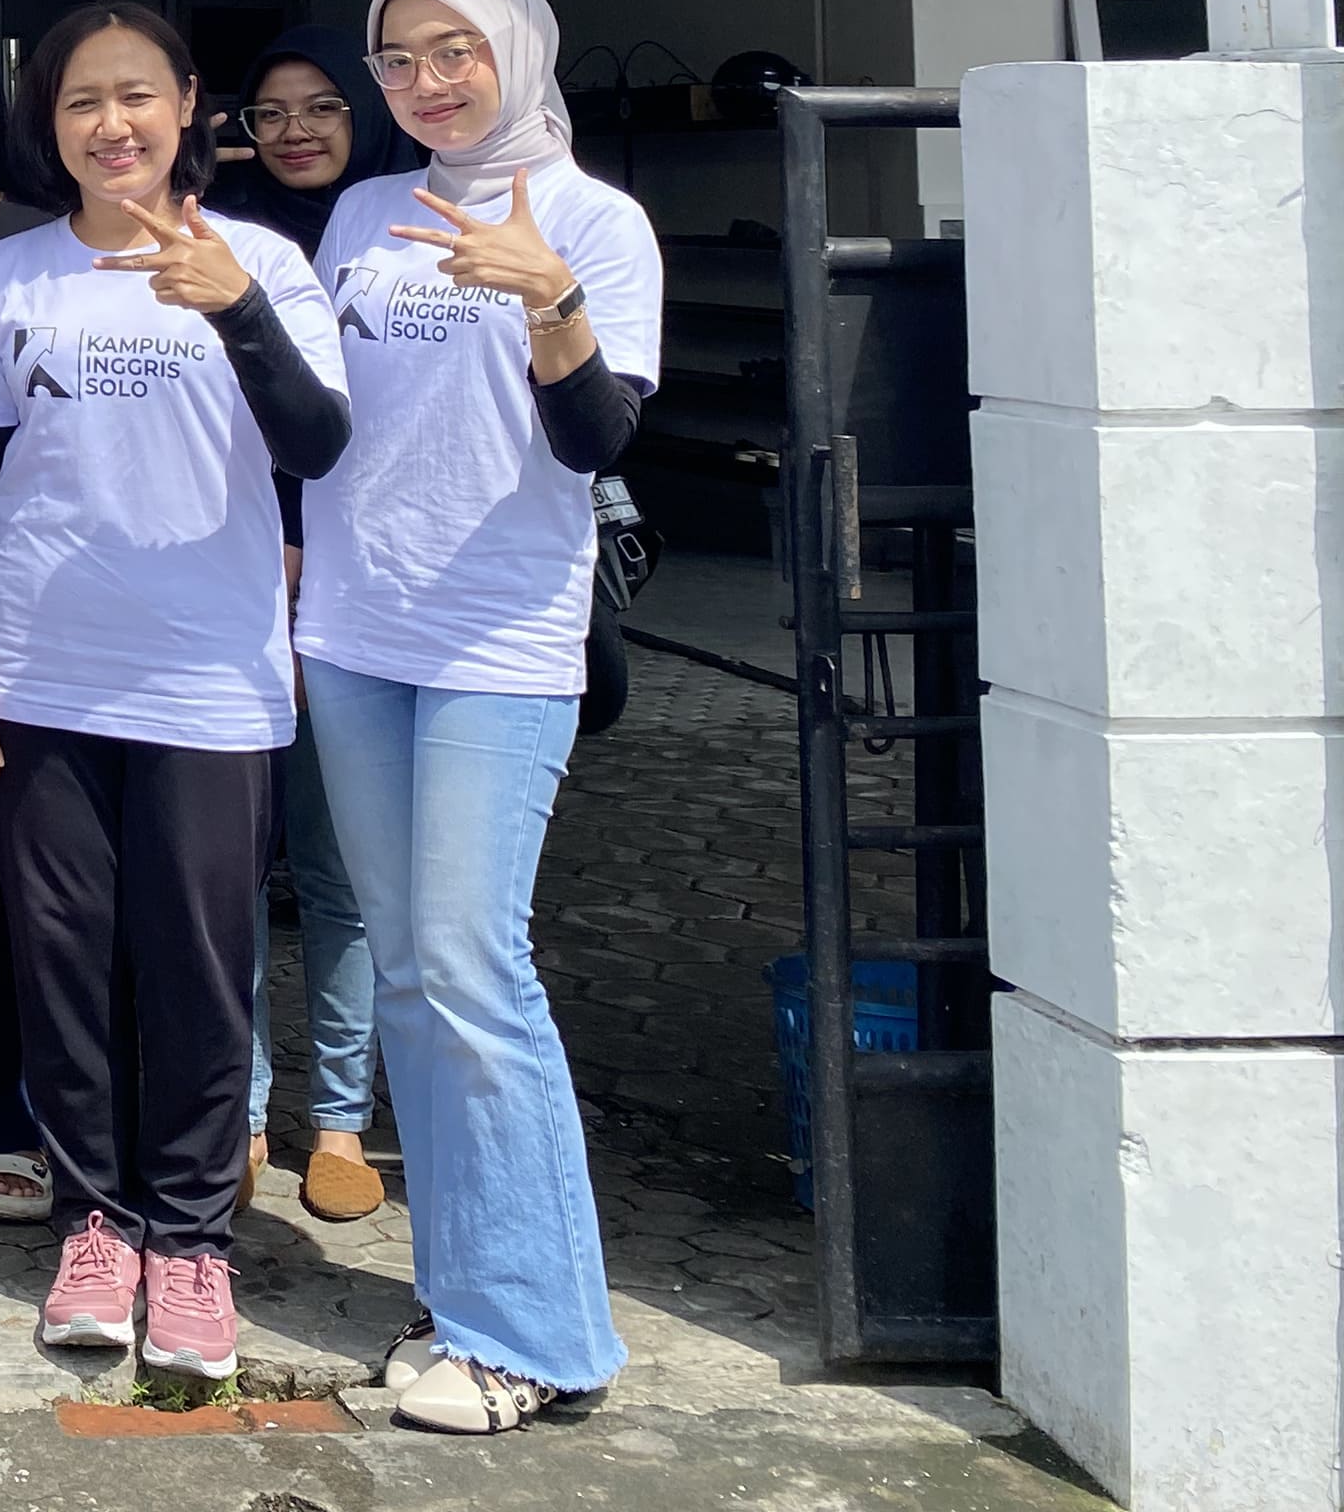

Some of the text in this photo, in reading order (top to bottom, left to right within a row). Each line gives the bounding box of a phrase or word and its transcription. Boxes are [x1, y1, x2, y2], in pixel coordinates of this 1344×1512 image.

[399, 282, 510, 306] KAMPUNG
[393, 300, 481, 324] INGGRIS
[390, 321, 448, 342] SOLO
[86, 336, 206, 361] KAMPUNG
[85, 356, 180, 379] INGGRIS
[84, 378, 148, 398] SOLO
